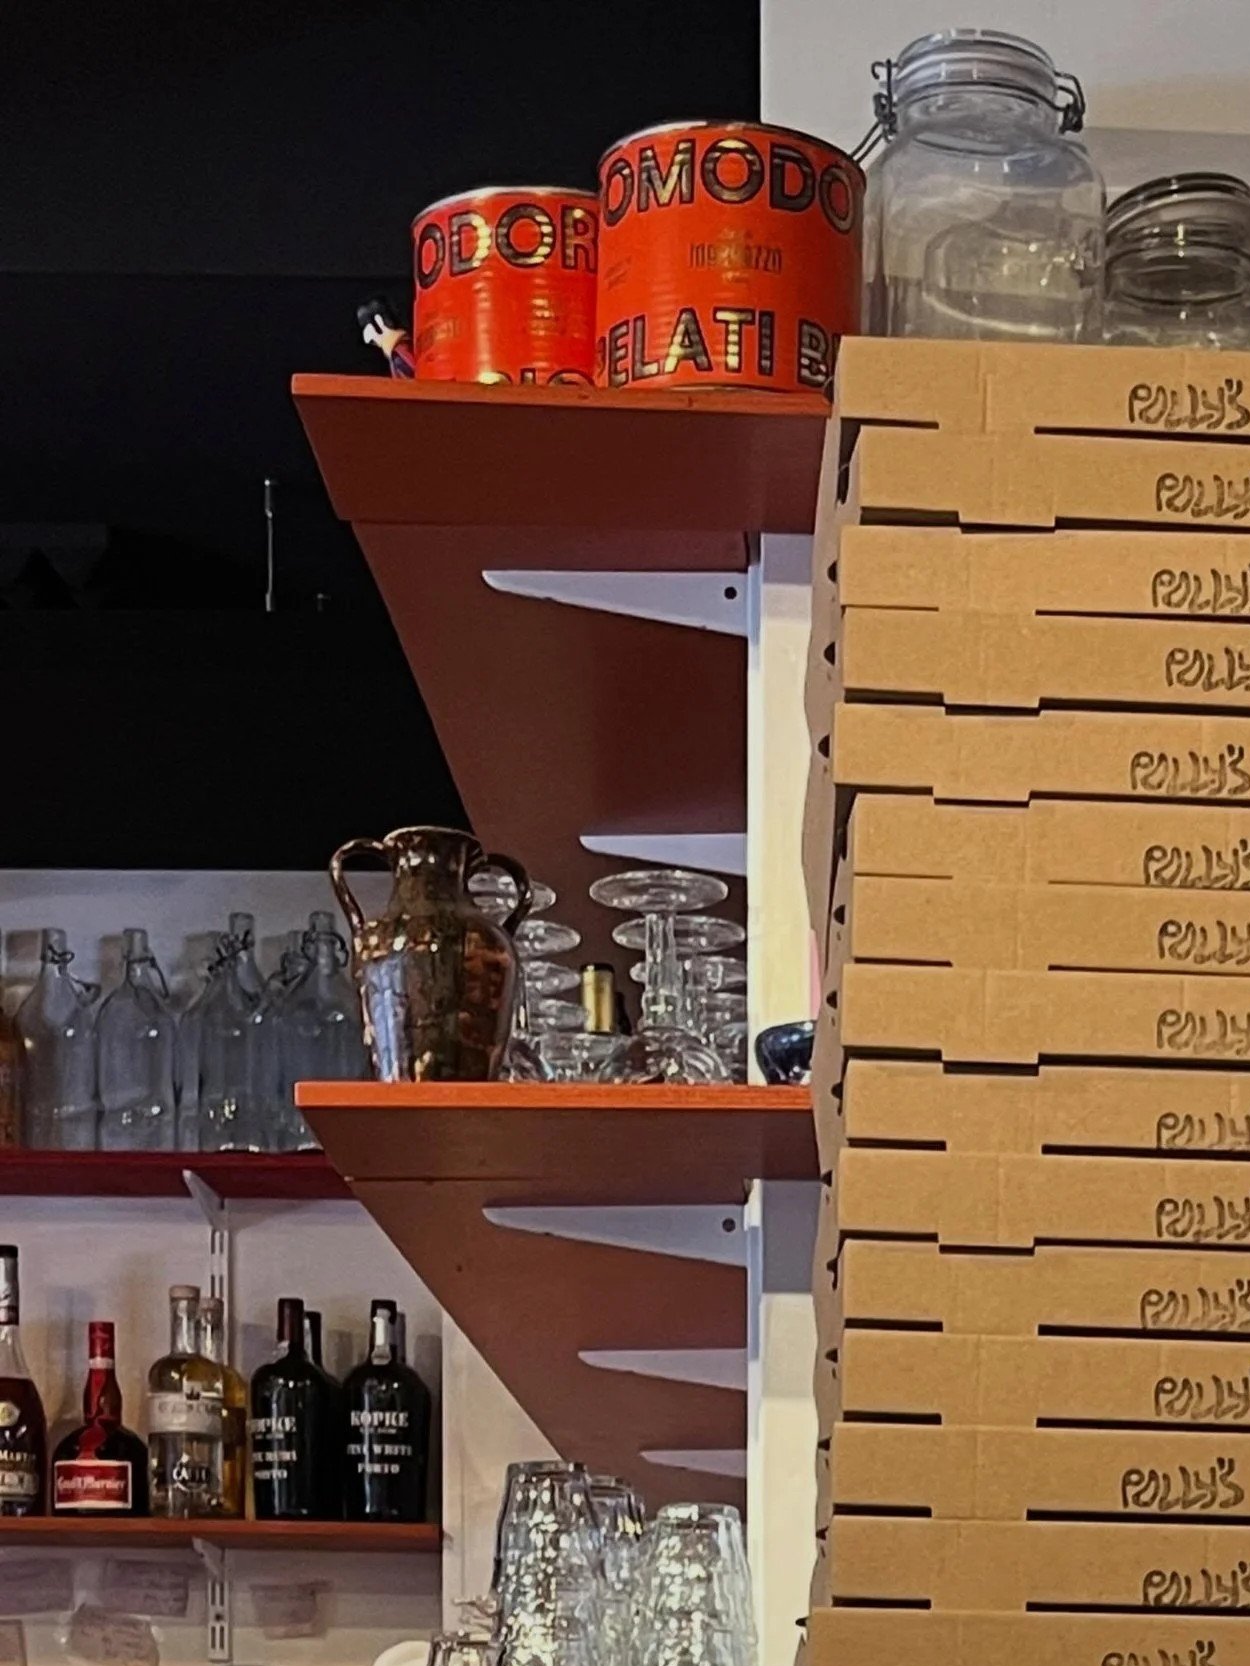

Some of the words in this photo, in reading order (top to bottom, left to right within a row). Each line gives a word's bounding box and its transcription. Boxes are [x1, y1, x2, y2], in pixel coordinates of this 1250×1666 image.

[602, 138, 856, 234] OMODO
[418, 203, 597, 290] ODOR
[350, 1410, 409, 1428] KOPKE
